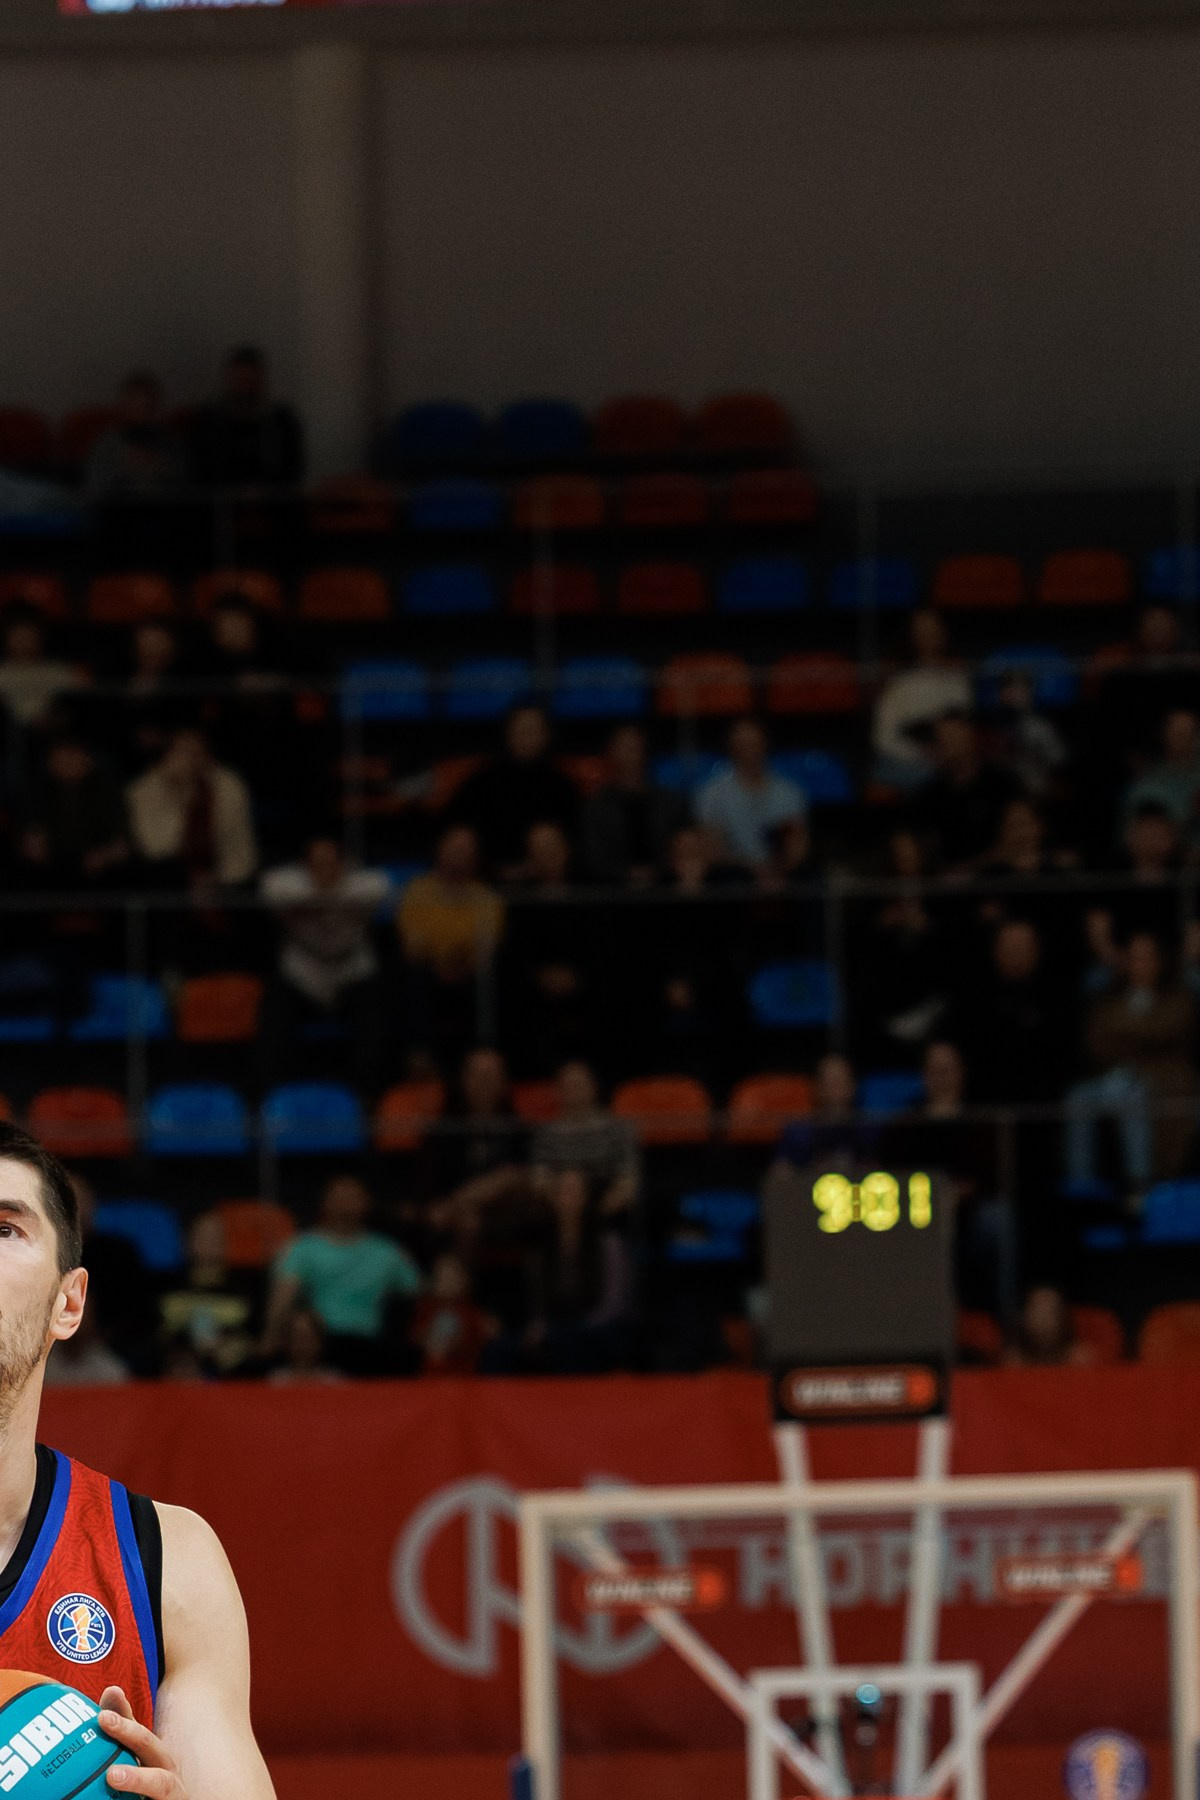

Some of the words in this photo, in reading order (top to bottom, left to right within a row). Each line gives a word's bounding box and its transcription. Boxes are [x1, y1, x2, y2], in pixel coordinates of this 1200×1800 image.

[813, 1171, 932, 1233] 9:01
[56, 1639, 67, 1653] VTB
[66, 1650, 90, 1660] UNITED
[90, 1641, 109, 1659] LEAGUE
